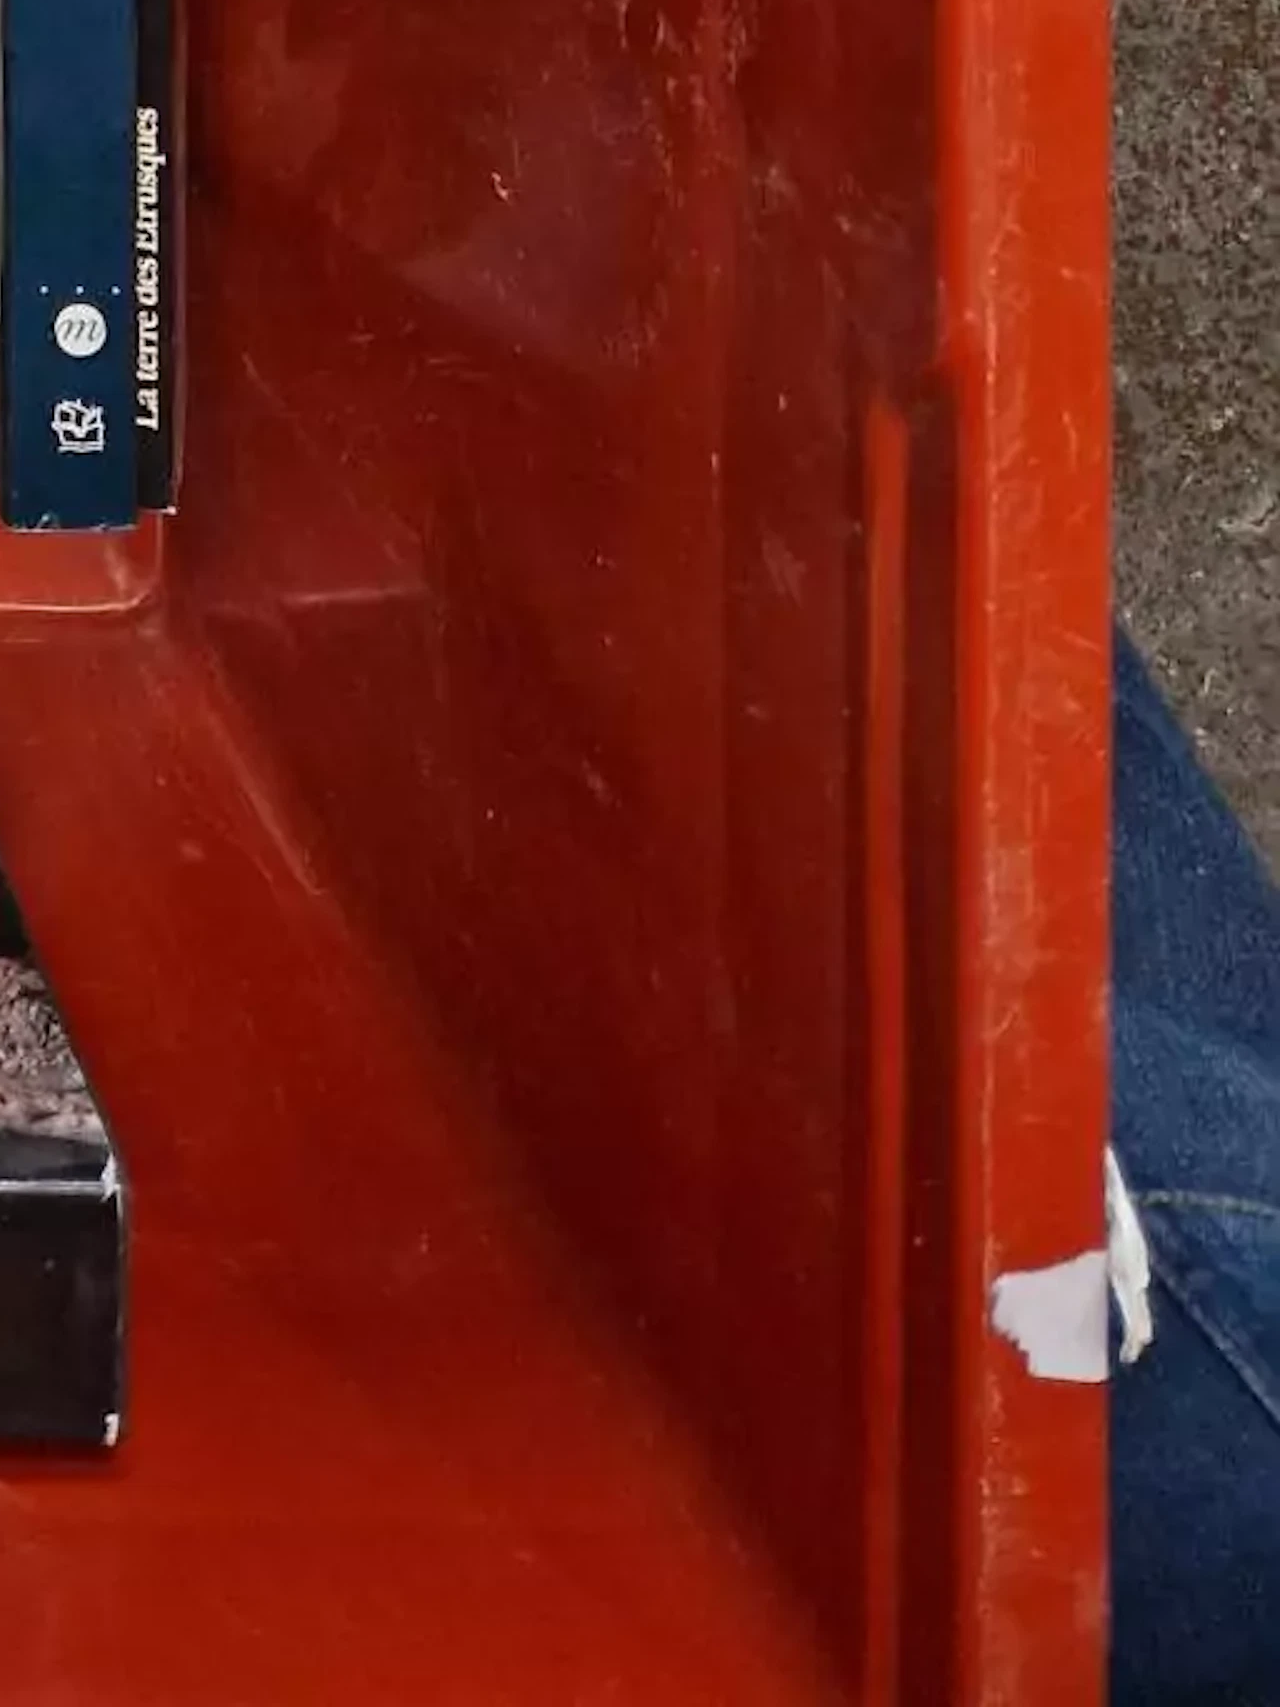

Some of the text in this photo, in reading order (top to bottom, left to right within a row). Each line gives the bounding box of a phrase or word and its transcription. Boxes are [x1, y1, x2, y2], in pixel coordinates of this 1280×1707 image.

[132, 105, 167, 431] La terre des Etrusques
